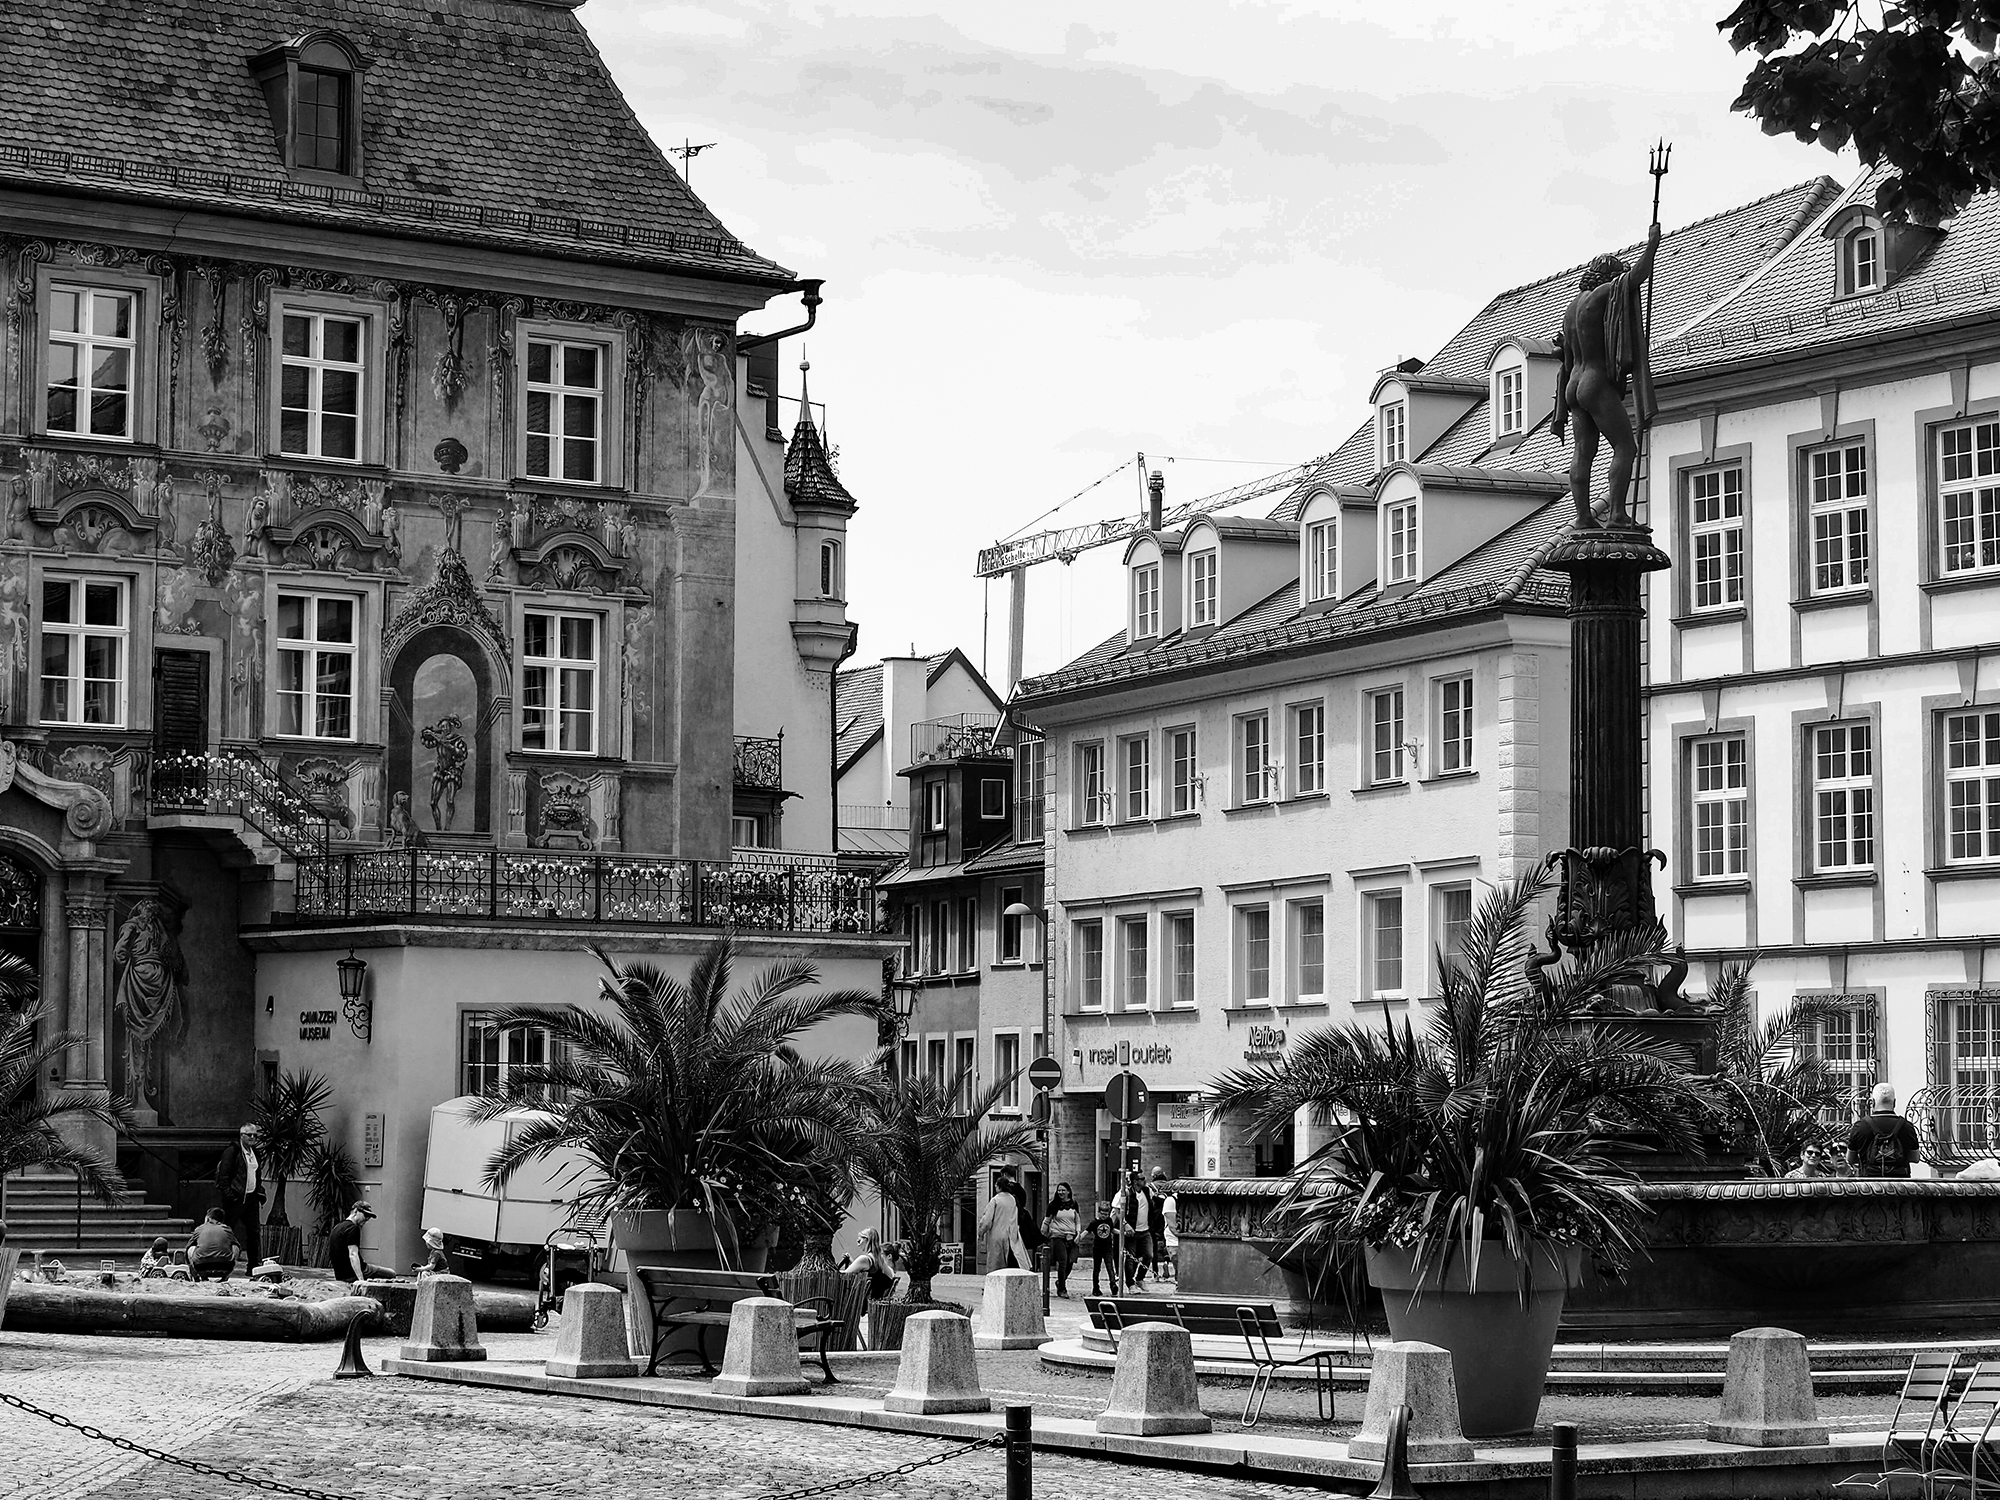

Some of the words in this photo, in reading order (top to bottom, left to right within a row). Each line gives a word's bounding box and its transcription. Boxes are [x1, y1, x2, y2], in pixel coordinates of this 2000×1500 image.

[299, 1026, 331, 1040] MUSEUM
[1248, 1025, 1276, 1047] Netto
[1089, 1043, 1118, 1065] insel
[1132, 1042, 1172, 1064] outlet
